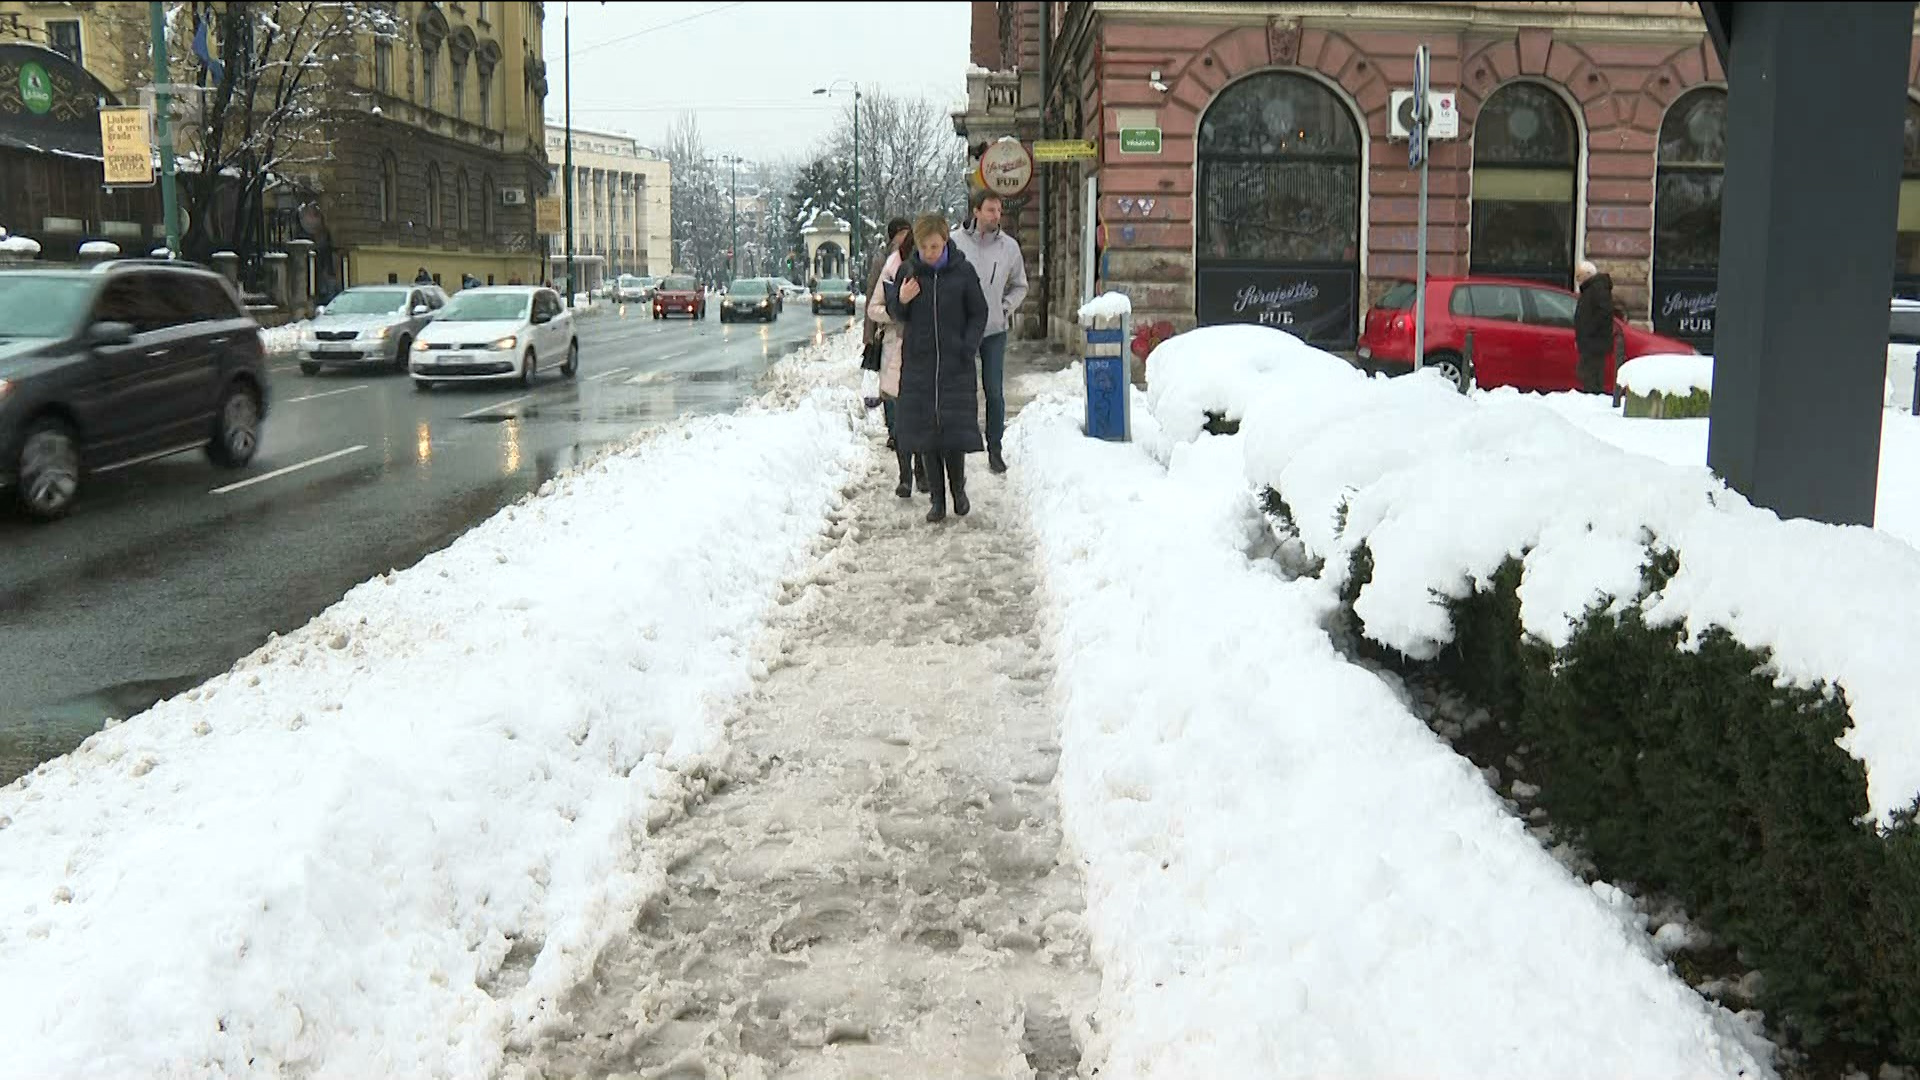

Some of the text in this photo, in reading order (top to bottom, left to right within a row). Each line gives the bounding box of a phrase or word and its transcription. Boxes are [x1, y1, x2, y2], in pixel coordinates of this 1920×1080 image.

[997, 177, 1019, 186] PUB
[1258, 311, 1294, 324] PUB
[1679, 317, 1712, 331] PUB
